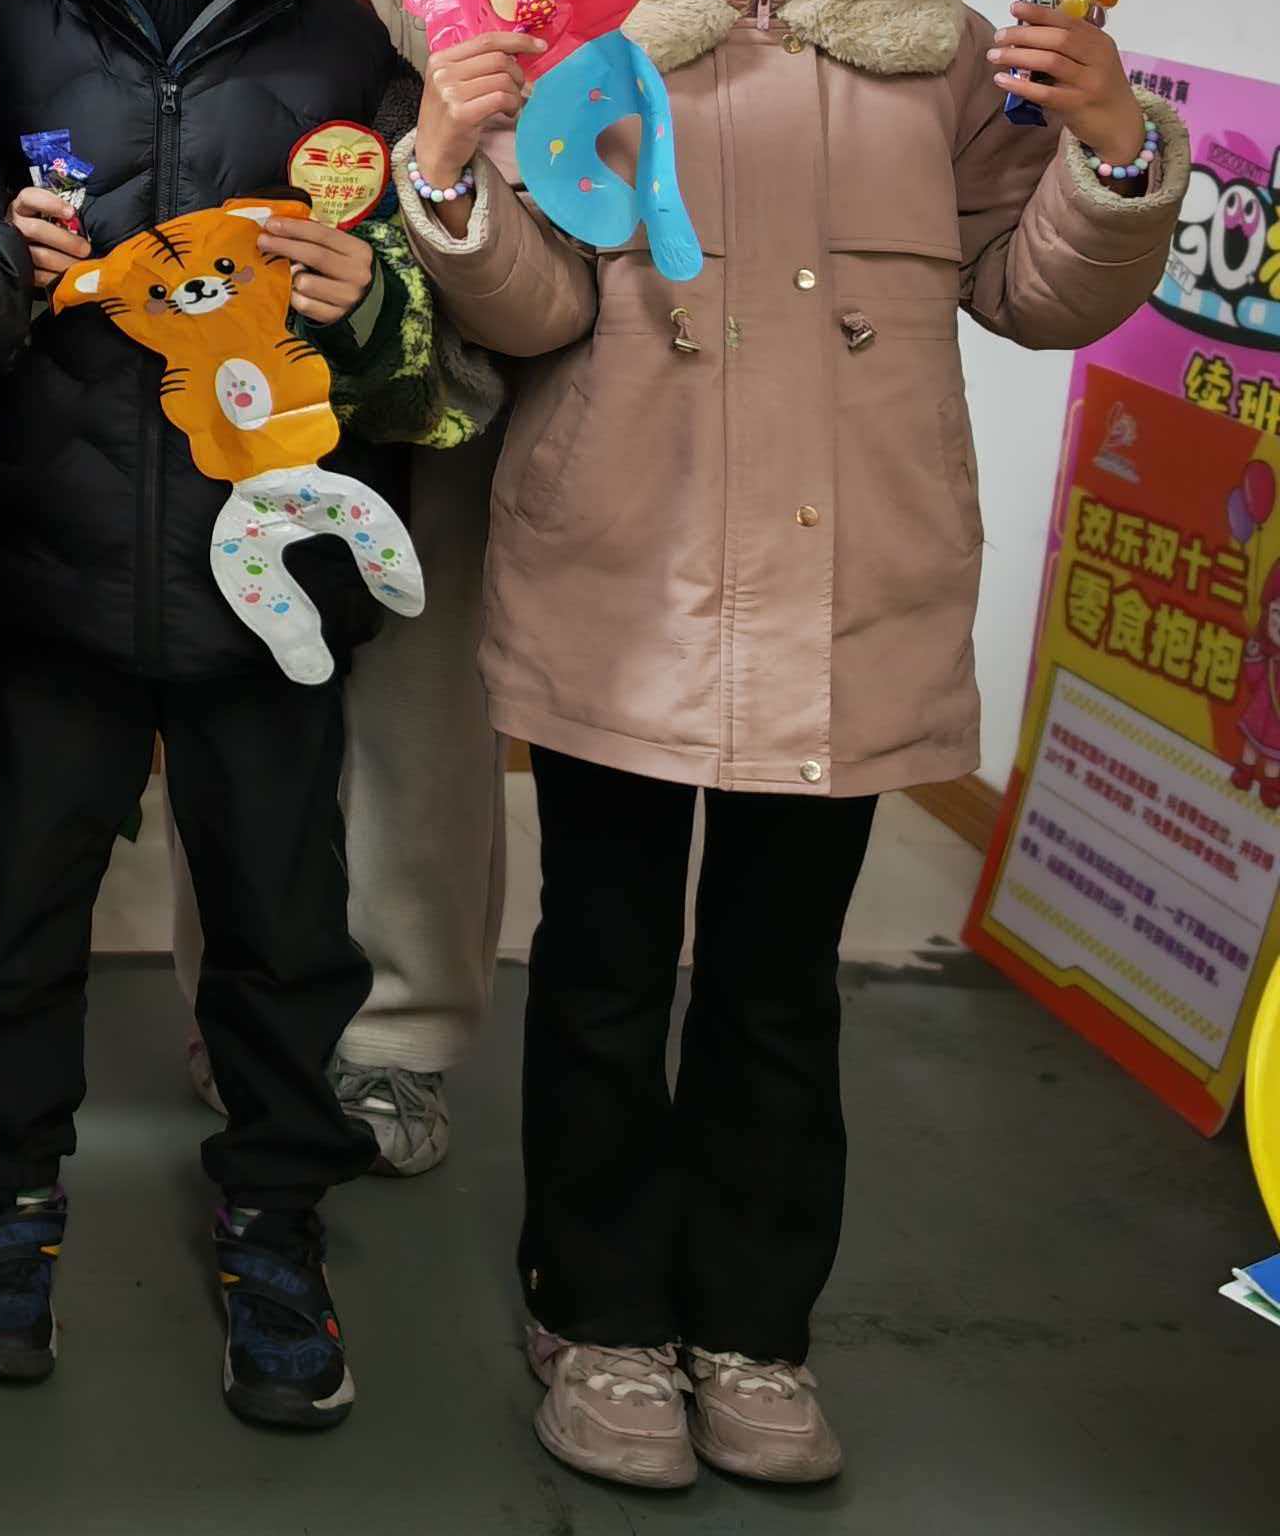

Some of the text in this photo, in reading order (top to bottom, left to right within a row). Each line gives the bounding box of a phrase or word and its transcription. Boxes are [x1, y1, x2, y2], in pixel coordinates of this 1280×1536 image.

[1077, 499, 1246, 606] 欢乐双十二
